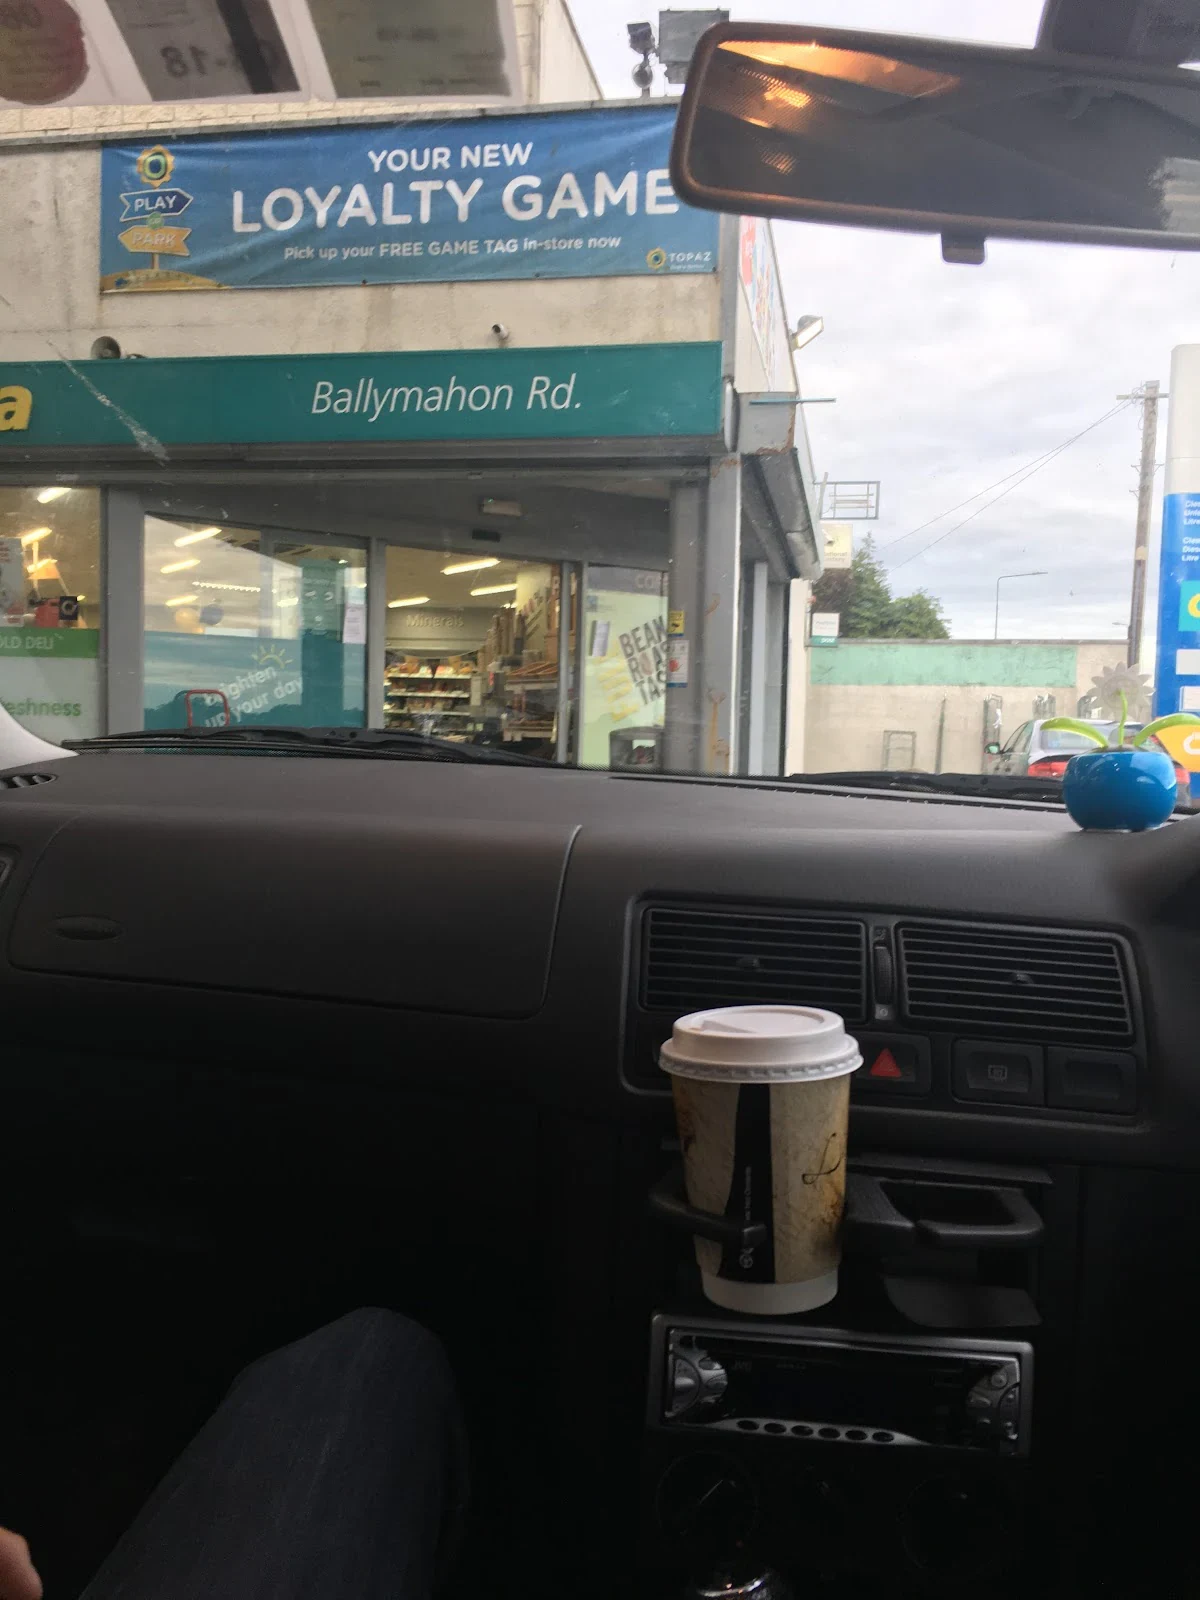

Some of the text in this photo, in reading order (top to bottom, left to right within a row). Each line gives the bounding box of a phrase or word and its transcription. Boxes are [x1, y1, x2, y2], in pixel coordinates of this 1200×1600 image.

[368, 142, 533, 173] YOUR NEW
[134, 195, 177, 212] PLAY
[232, 169, 680, 233] LOYALTY GAME
[131, 231, 176, 247] PARK
[283, 236, 622, 260] Pick up your FREE GAME TAG in-store now
[669, 251, 712, 263] TOPAZ
[311, 372, 581, 423] Ballymahon Rd.
[406, 613, 465, 628] Minerals
[25, 636, 54, 650] DELI
[3, 697, 81, 717] eshness
